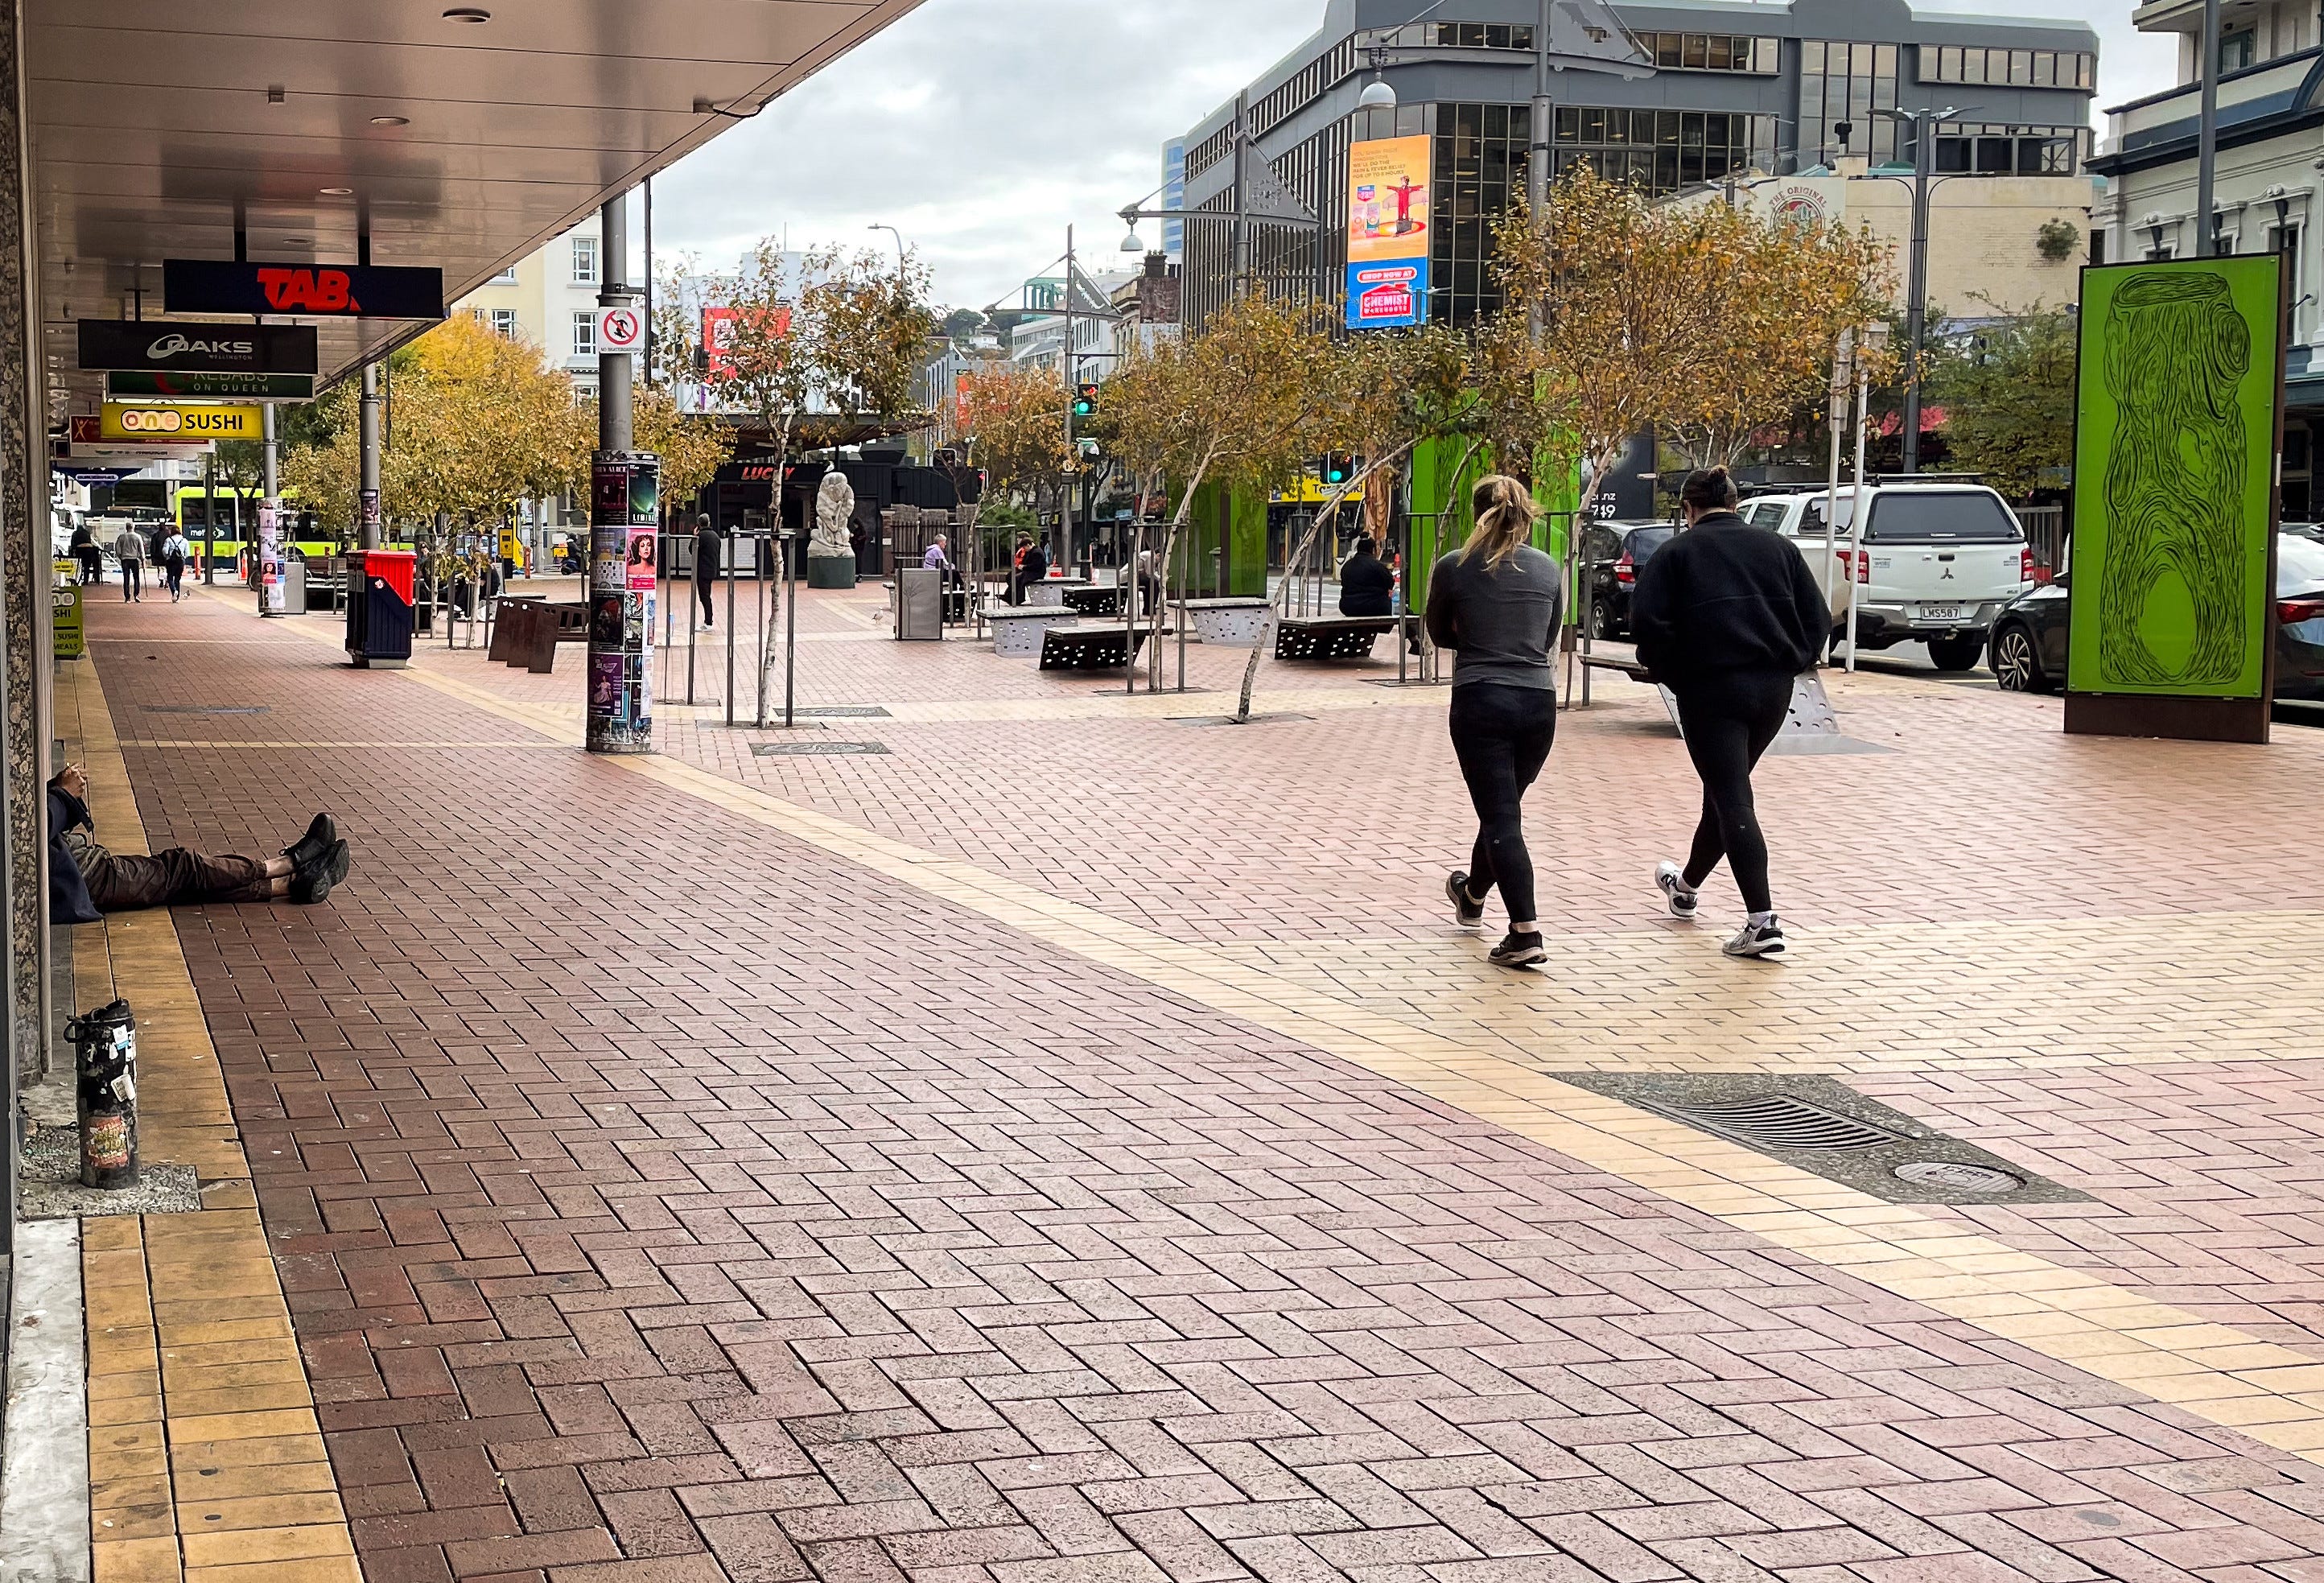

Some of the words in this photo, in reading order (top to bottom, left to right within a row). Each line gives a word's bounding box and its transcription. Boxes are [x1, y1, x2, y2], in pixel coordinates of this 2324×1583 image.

[1769, 191, 1785, 207] THE
[1787, 186, 1827, 208] ORIGINAL
[1362, 273, 1382, 281] SHOP
[1383, 270, 1402, 278] NOW
[258, 268, 352, 311] TAB
[1364, 294, 1409, 308] CHEMIST
[1364, 305, 1407, 314] WAREHOUSE
[146, 334, 253, 359] OAKS
[193, 383, 212, 392] ON
[221, 384, 269, 393] QUEEN
[124, 413, 178, 428] one
[185, 414, 243, 431] SUSHI
[741, 467, 795, 480] LUCY
[54, 609, 71, 618] SHI
